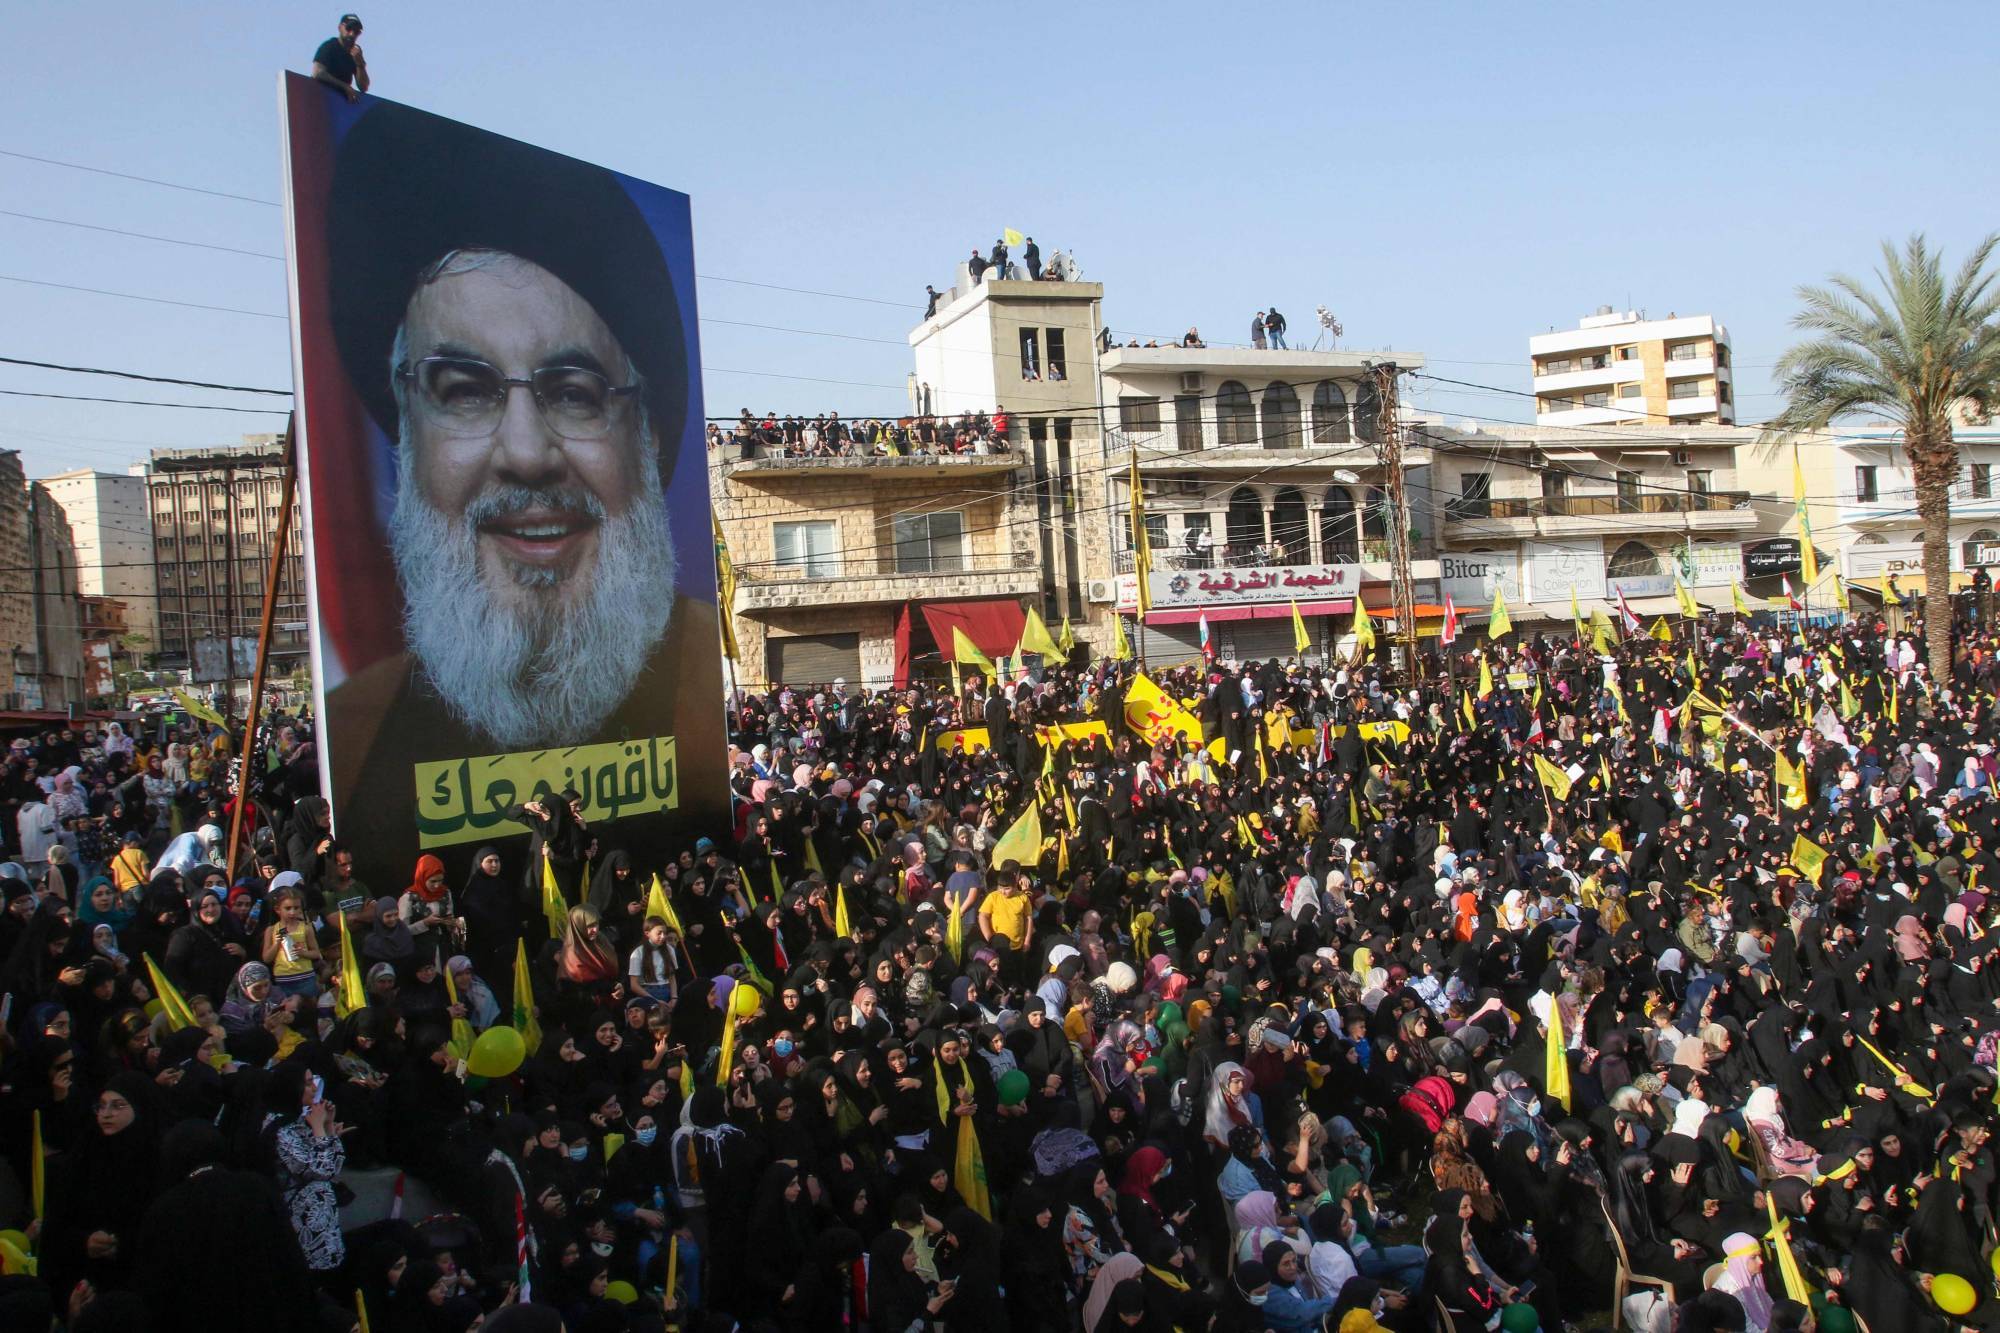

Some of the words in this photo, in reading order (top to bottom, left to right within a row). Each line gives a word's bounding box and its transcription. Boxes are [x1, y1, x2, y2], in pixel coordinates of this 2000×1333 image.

[1283, 568, 1343, 591] النجمة
[1442, 558, 1489, 579] Bitar
[1698, 564, 1741, 574] FASHION
[1198, 571, 1277, 596] الشرقية
